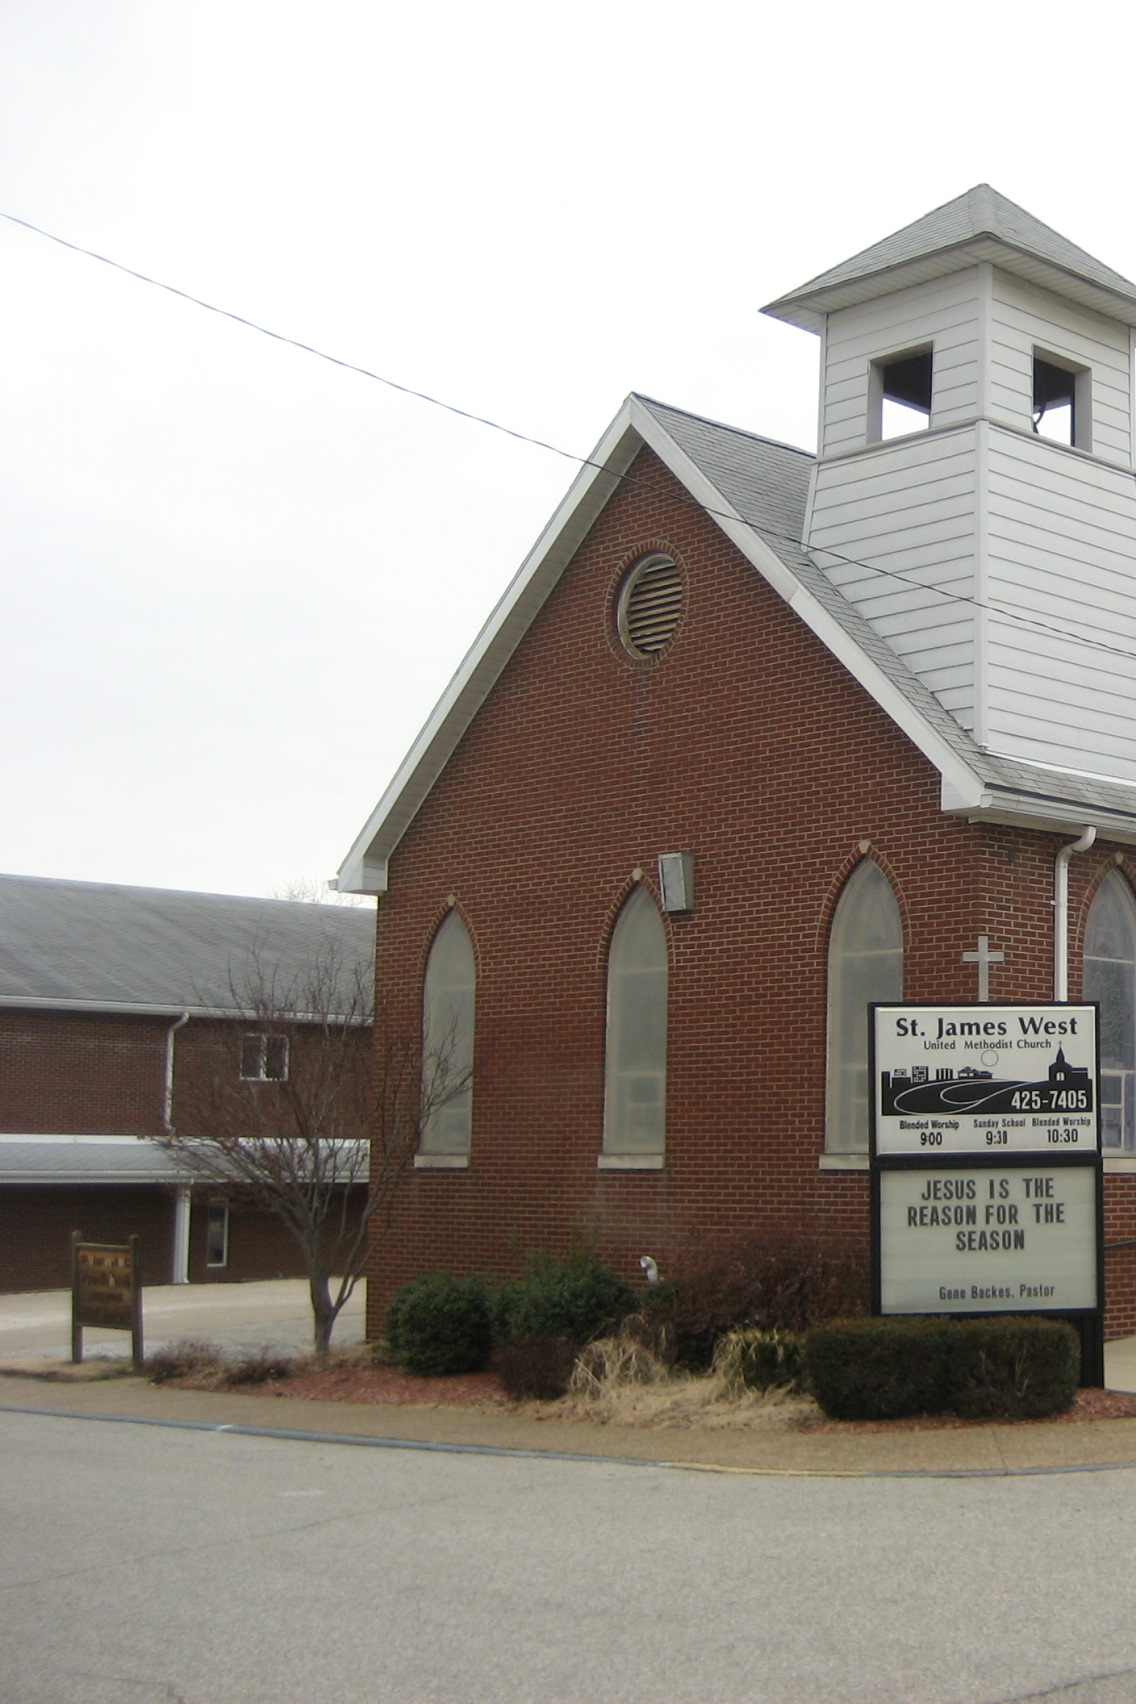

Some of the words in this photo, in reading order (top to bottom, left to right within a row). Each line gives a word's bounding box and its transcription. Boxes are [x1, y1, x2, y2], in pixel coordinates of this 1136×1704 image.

[896, 1017, 925, 1037] St.
[936, 1017, 1007, 1039] James
[1018, 1017, 1078, 1035] West
[924, 1040, 956, 1050] United
[964, 1040, 1012, 1049] Methodist
[1017, 1039, 1051, 1049] Church
[1011, 1090, 1087, 1109] 425-7405
[900, 1120, 929, 1129] Blended
[931, 1120, 960, 1130] Worship
[973, 1119, 999, 1128] Sunday
[1002, 1118, 1026, 1127] School
[1032, 1118, 1060, 1126] Blended
[1063, 1117, 1091, 1126] Worship
[921, 1132, 942, 1145] 9:00
[986, 1131, 1007, 1145] 9:30
[1047, 1129, 1078, 1143] 10:30
[922, 1179, 976, 1200] JESUS
[989, 1179, 1009, 1199] IS
[1023, 1178, 1054, 1198] THE
[908, 1205, 977, 1226] REASON
[985, 1204, 1018, 1225] FOR
[1033, 1203, 1065, 1223] THE
[956, 1230, 1024, 1251] SEASON
[939, 1287, 965, 1300] Gene
[1020, 1284, 1055, 1297] Pastor
